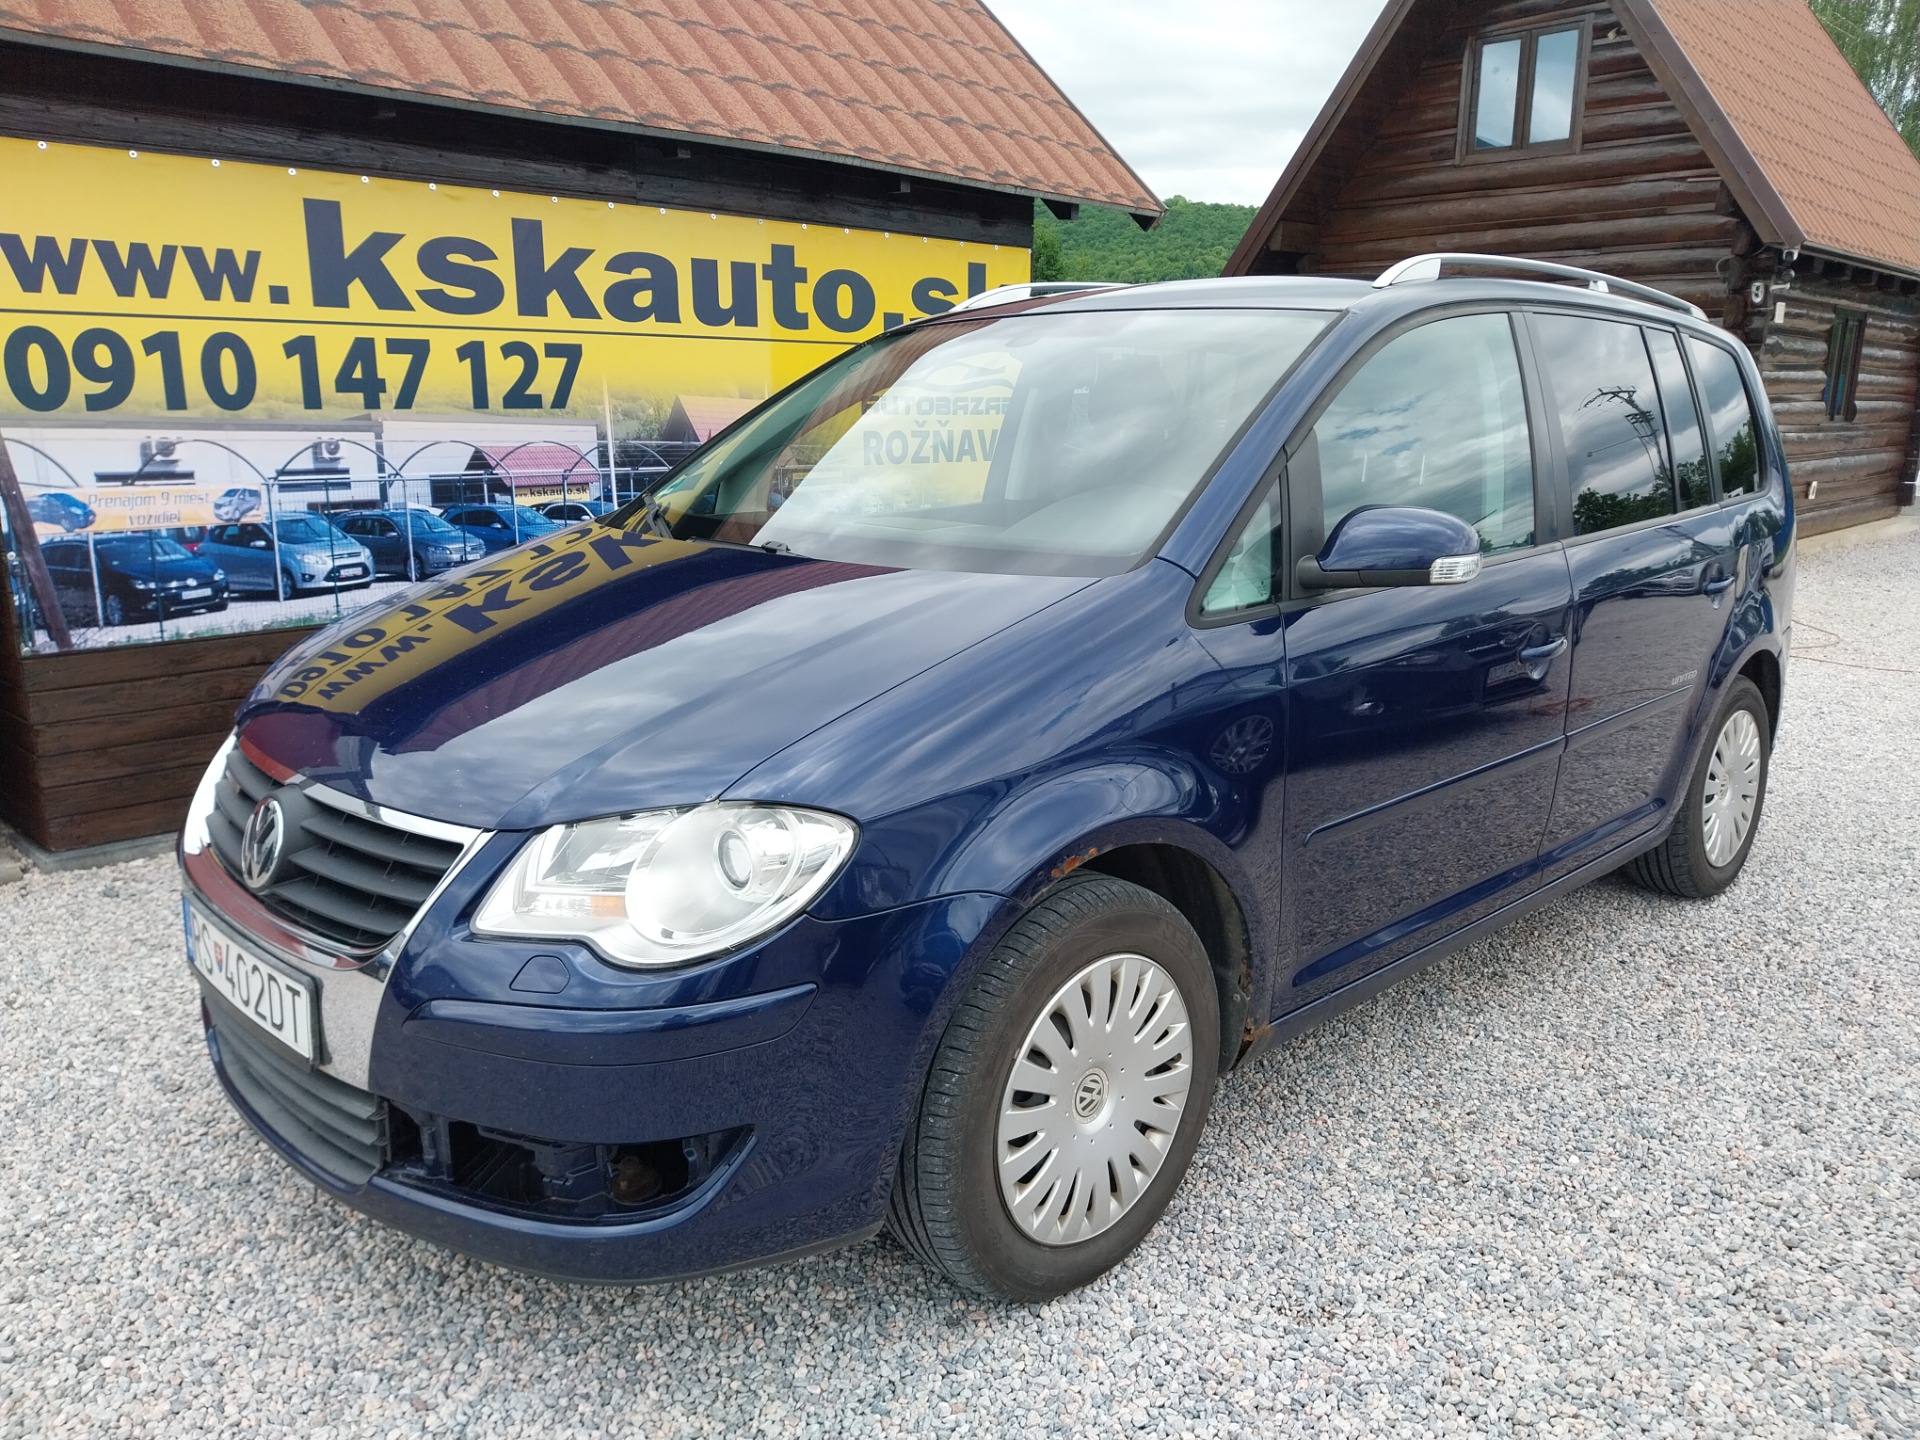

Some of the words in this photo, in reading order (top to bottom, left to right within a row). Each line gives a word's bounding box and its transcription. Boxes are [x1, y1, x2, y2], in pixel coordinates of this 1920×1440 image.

[4, 325, 257, 412] 0910
[283, 335, 431, 410] 147
[456, 340, 583, 410] 127
[88, 493, 156, 510] Prenajom
[161, 491, 169, 506] 9
[174, 492, 210, 505] miest
[129, 511, 181, 526] vozidiel
[225, 944, 301, 1043] 402DT
